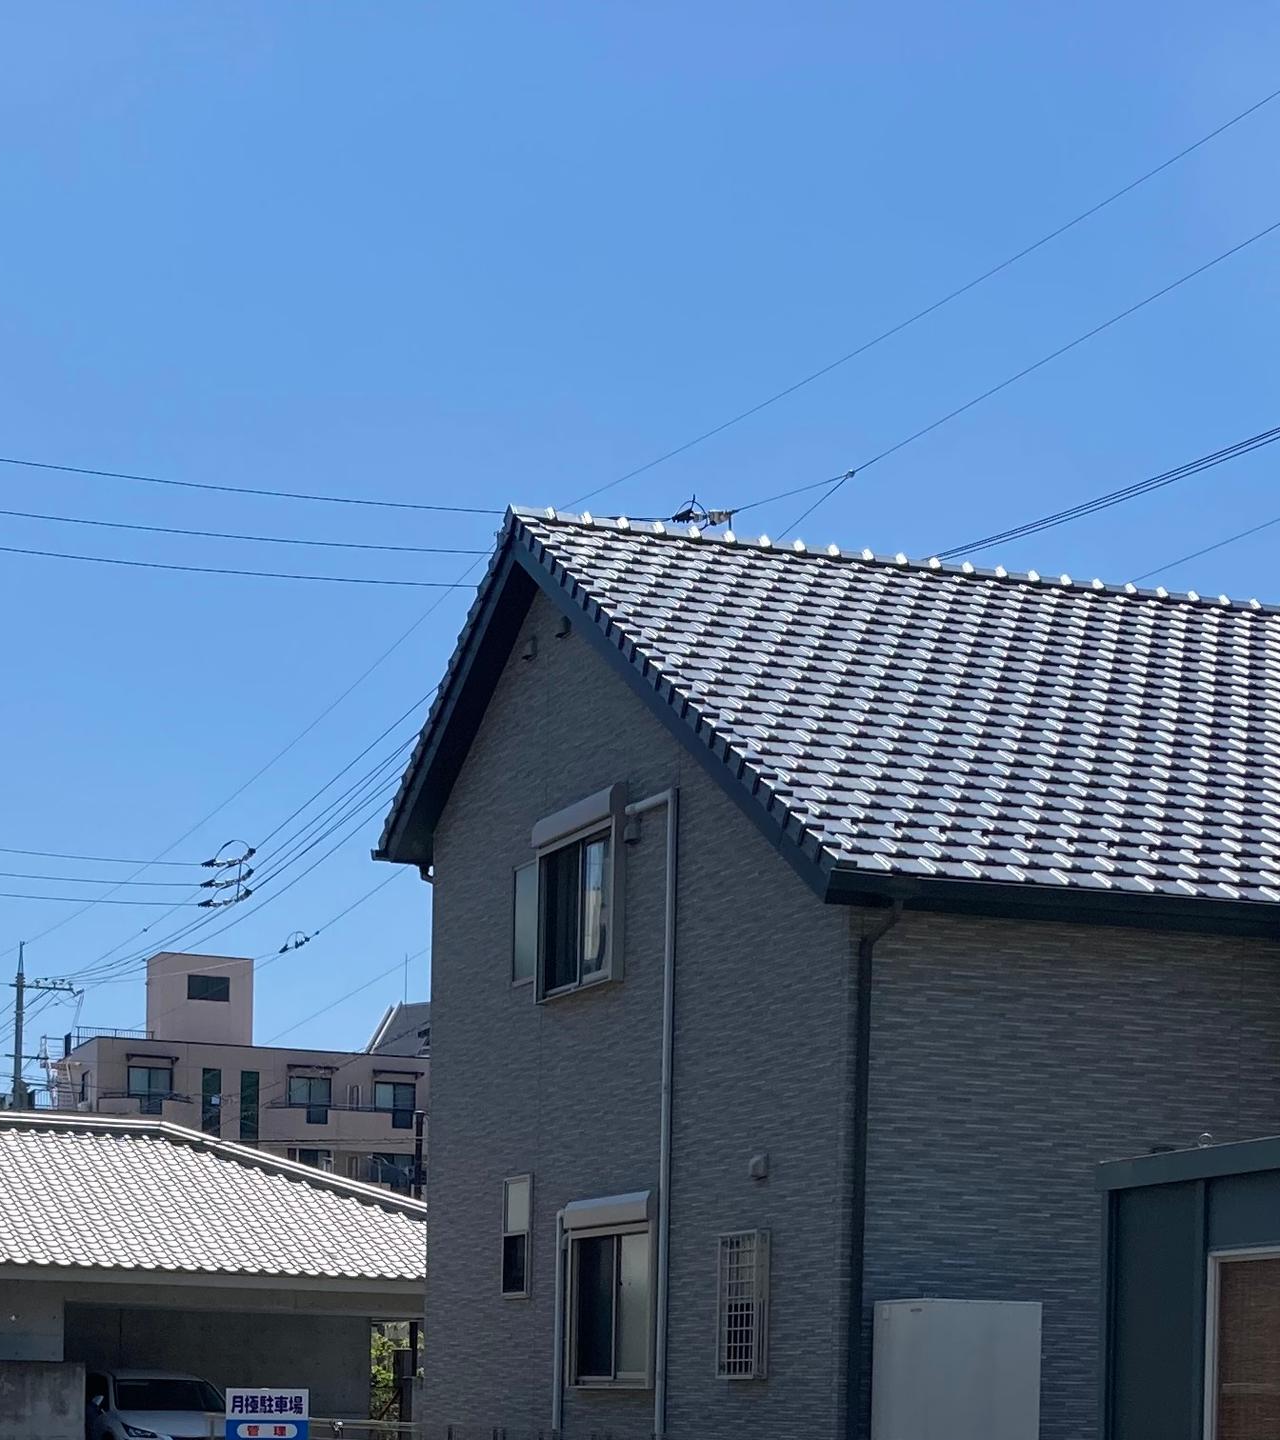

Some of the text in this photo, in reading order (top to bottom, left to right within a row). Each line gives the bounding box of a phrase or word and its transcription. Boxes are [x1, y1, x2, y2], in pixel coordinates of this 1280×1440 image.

[231, 1395, 303, 1414] 月極駐車場
